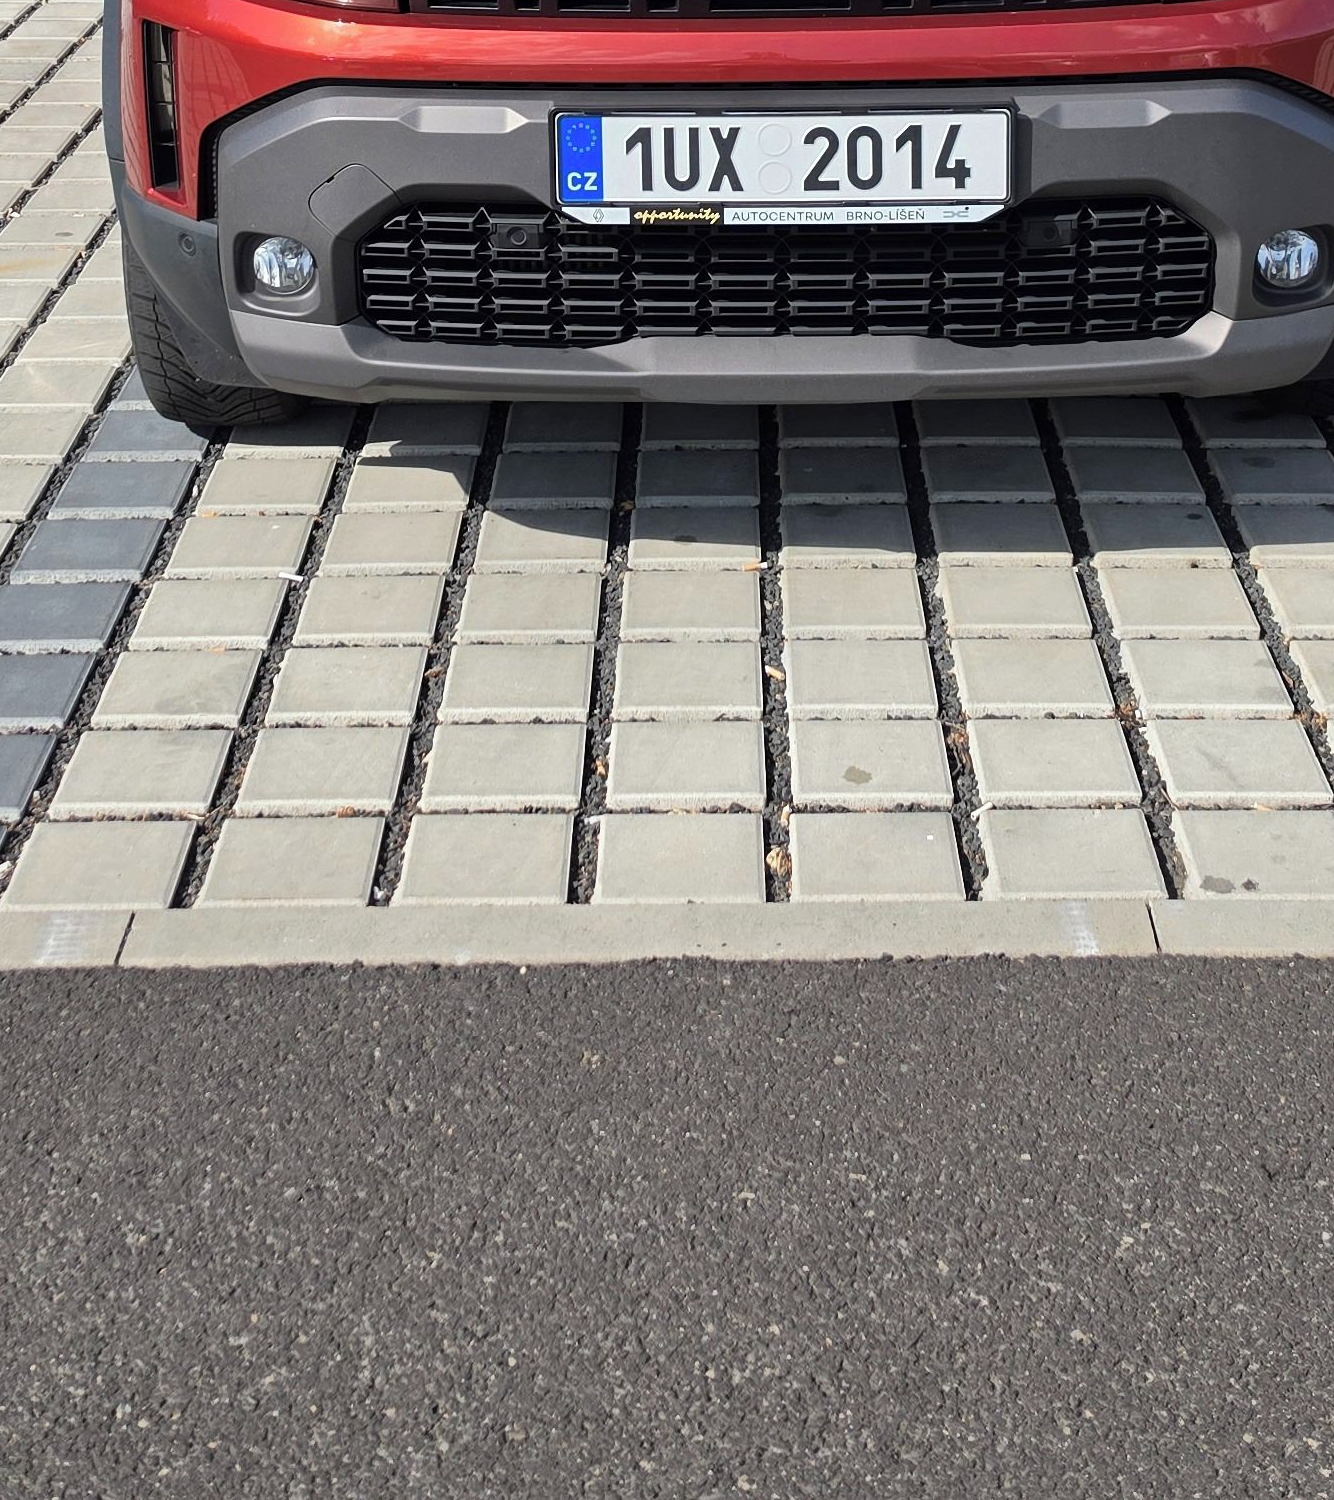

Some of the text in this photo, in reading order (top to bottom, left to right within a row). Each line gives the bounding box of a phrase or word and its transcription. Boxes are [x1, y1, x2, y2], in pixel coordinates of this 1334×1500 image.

[566, 123, 972, 192] CZ 1UX 2014
[633, 207, 926, 224] opportunity AUTOCENTRUM BRNO-LÍŠEŇ
